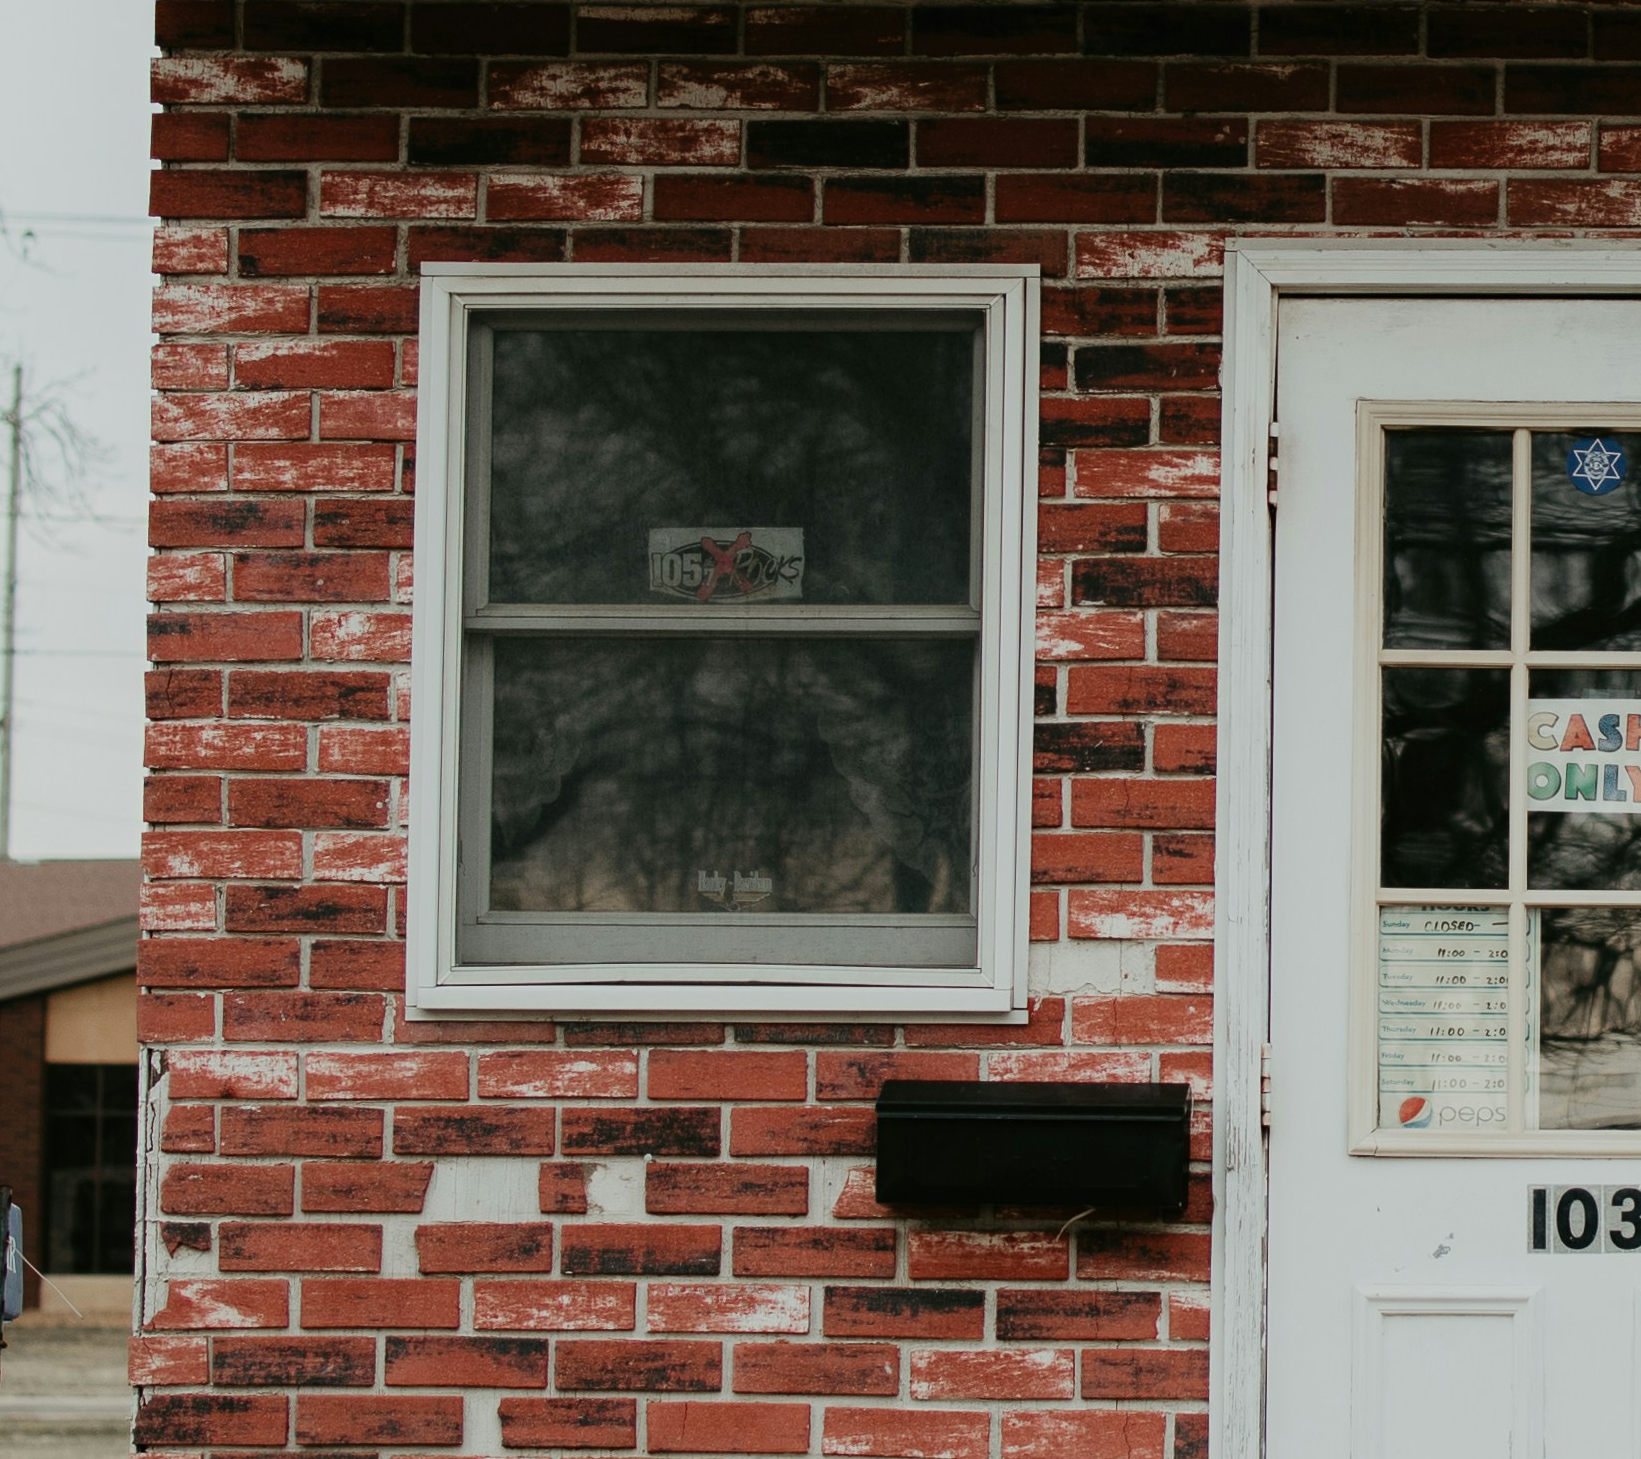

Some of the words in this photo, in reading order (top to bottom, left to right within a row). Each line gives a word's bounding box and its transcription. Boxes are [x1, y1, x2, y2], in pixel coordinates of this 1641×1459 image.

[1382, 920, 1411, 928] Sunday
[1437, 947, 1465, 958] 11:00
[1488, 949, 1508, 958] 2:0
[1435, 975, 1466, 984] 11:00
[1486, 975, 1508, 985] 2:0
[1382, 998, 1426, 1007] Wednesday
[1432, 1000, 1462, 1010] 11:00
[1485, 1001, 1507, 1010] 2:0
[1381, 1025, 1417, 1034] Thursday
[1429, 1027, 1465, 1037] 11:00
[1485, 1028, 1506, 1037] 2:0
[1381, 1052, 1406, 1060] Friday
[1430, 1053, 1462, 1062] 11:00
[1484, 1054, 1506, 1063] 2:0
[1381, 1078, 1415, 1086] Saturday
[1431, 1079, 1467, 1091] 11:00
[1484, 1078, 1505, 1089] 2:0
[1439, 1106, 1507, 1127] peps
